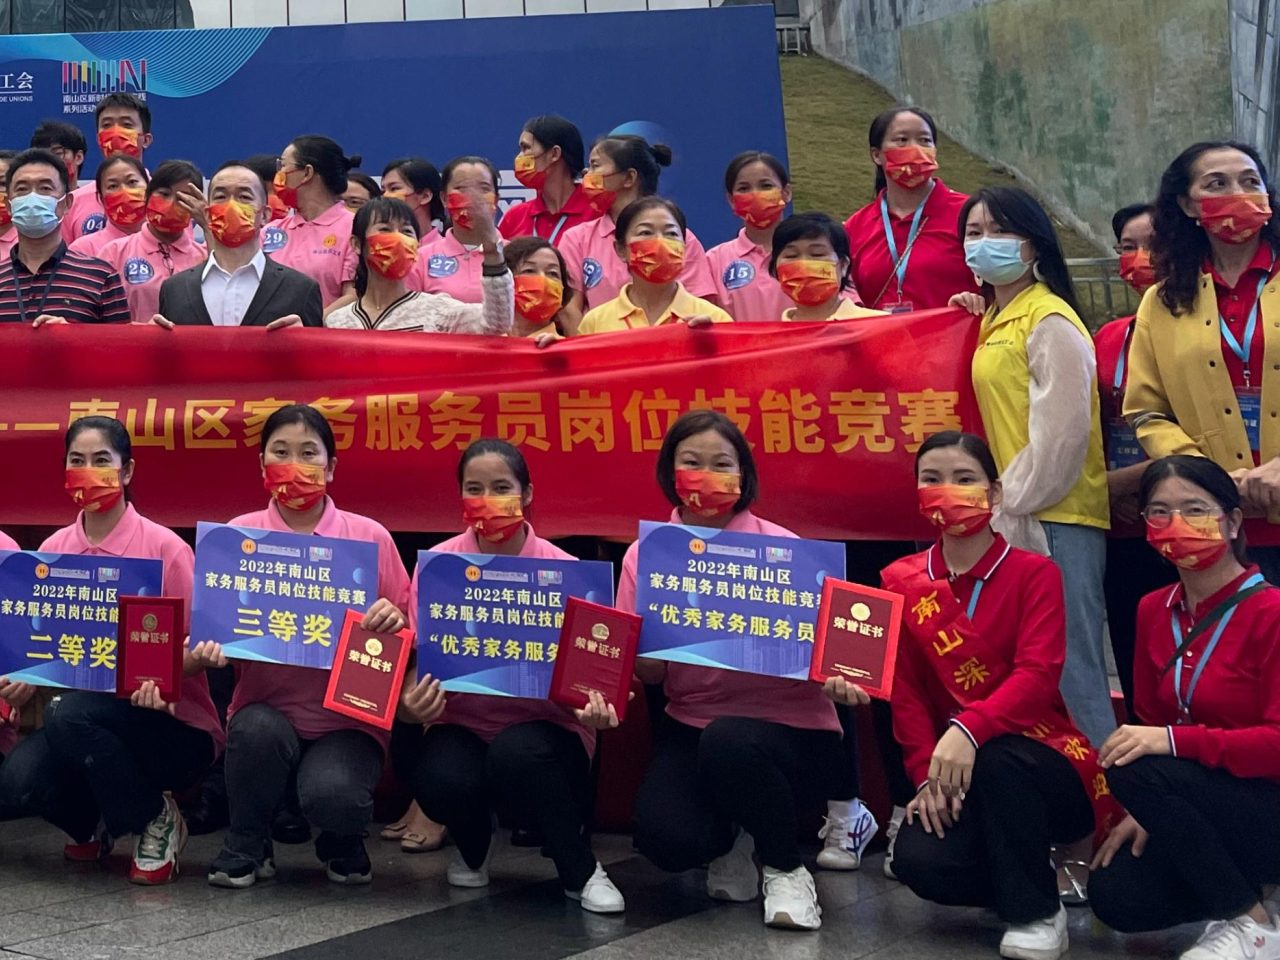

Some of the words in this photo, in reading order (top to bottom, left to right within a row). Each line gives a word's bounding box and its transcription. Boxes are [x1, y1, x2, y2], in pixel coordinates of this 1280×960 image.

[129, 264, 149, 275] 28
[431, 258, 455, 270] 27
[729, 267, 749, 281] 15
[239, 558, 332, 582] 2022年南山区
[687, 559, 792, 585] 2022年南山区
[33, 584, 118, 603] 2022年南山区
[205, 572, 367, 606] 家务服务员岗位技能竞赛
[464, 587, 563, 608] 2022年南山区
[233, 607, 333, 648] 三等奖
[833, 616, 885, 639] 荣誉证书
[26, 634, 117, 670] 二等奖
[574, 636, 621, 659] 荣誉证书
[347, 649, 393, 673] 荣誉证书
